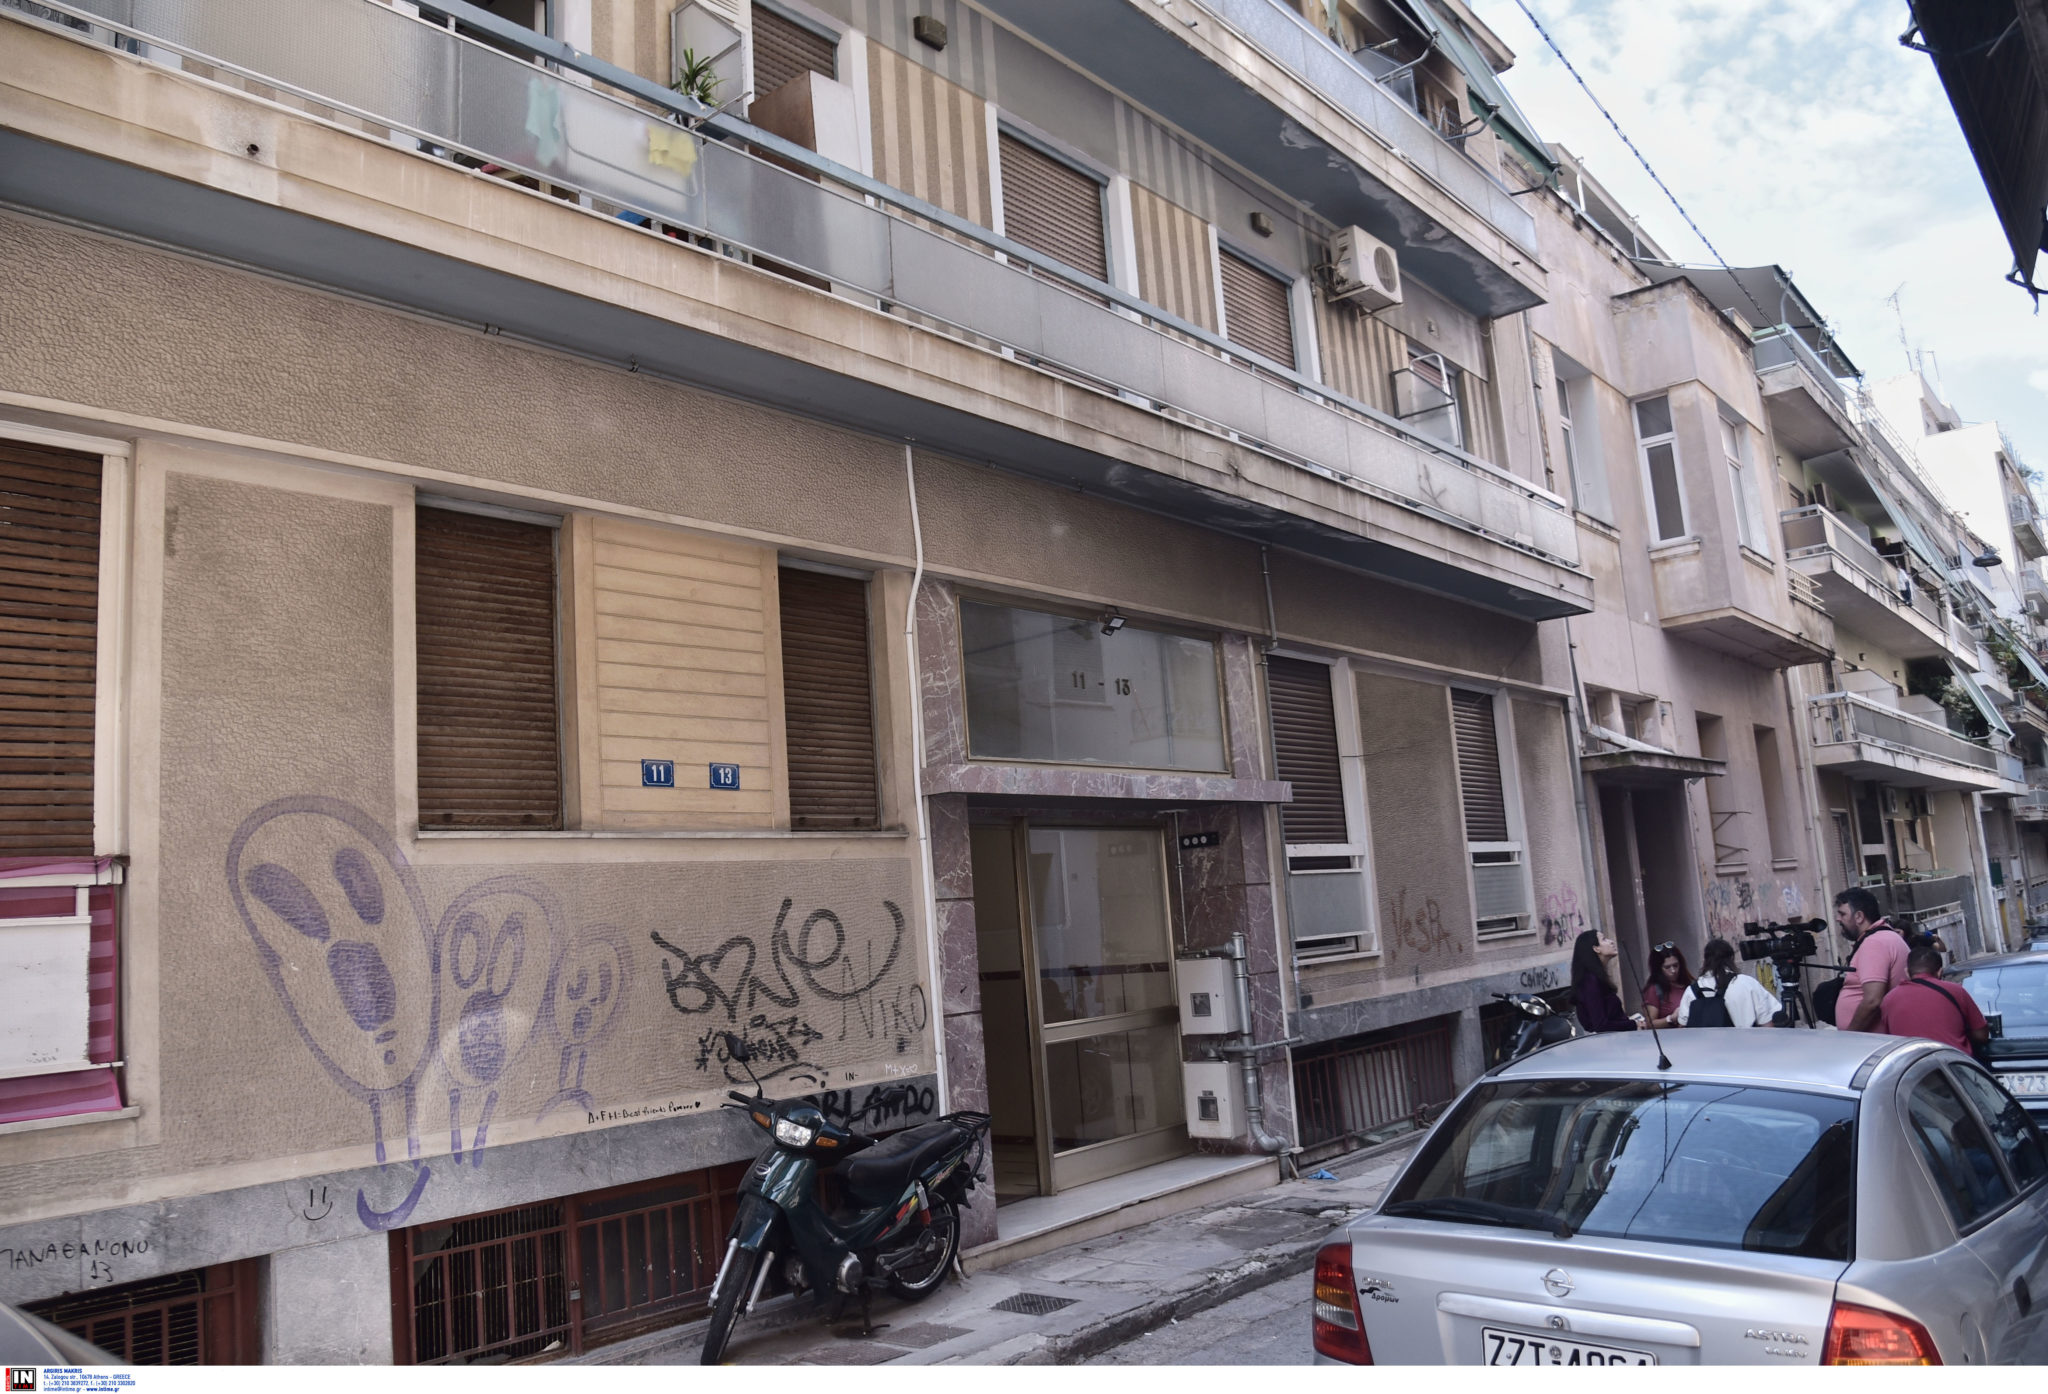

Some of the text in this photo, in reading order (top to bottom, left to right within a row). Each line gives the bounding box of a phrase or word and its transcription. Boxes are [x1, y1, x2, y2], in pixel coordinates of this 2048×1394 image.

[1071, 670, 1086, 690] 11
[1115, 678, 1131, 696] 13
[651, 764, 665, 782] 11
[719, 767, 732, 784] 13
[90, 1259, 114, 1282] 13
[1744, 1328, 1808, 1345] ASTRA
